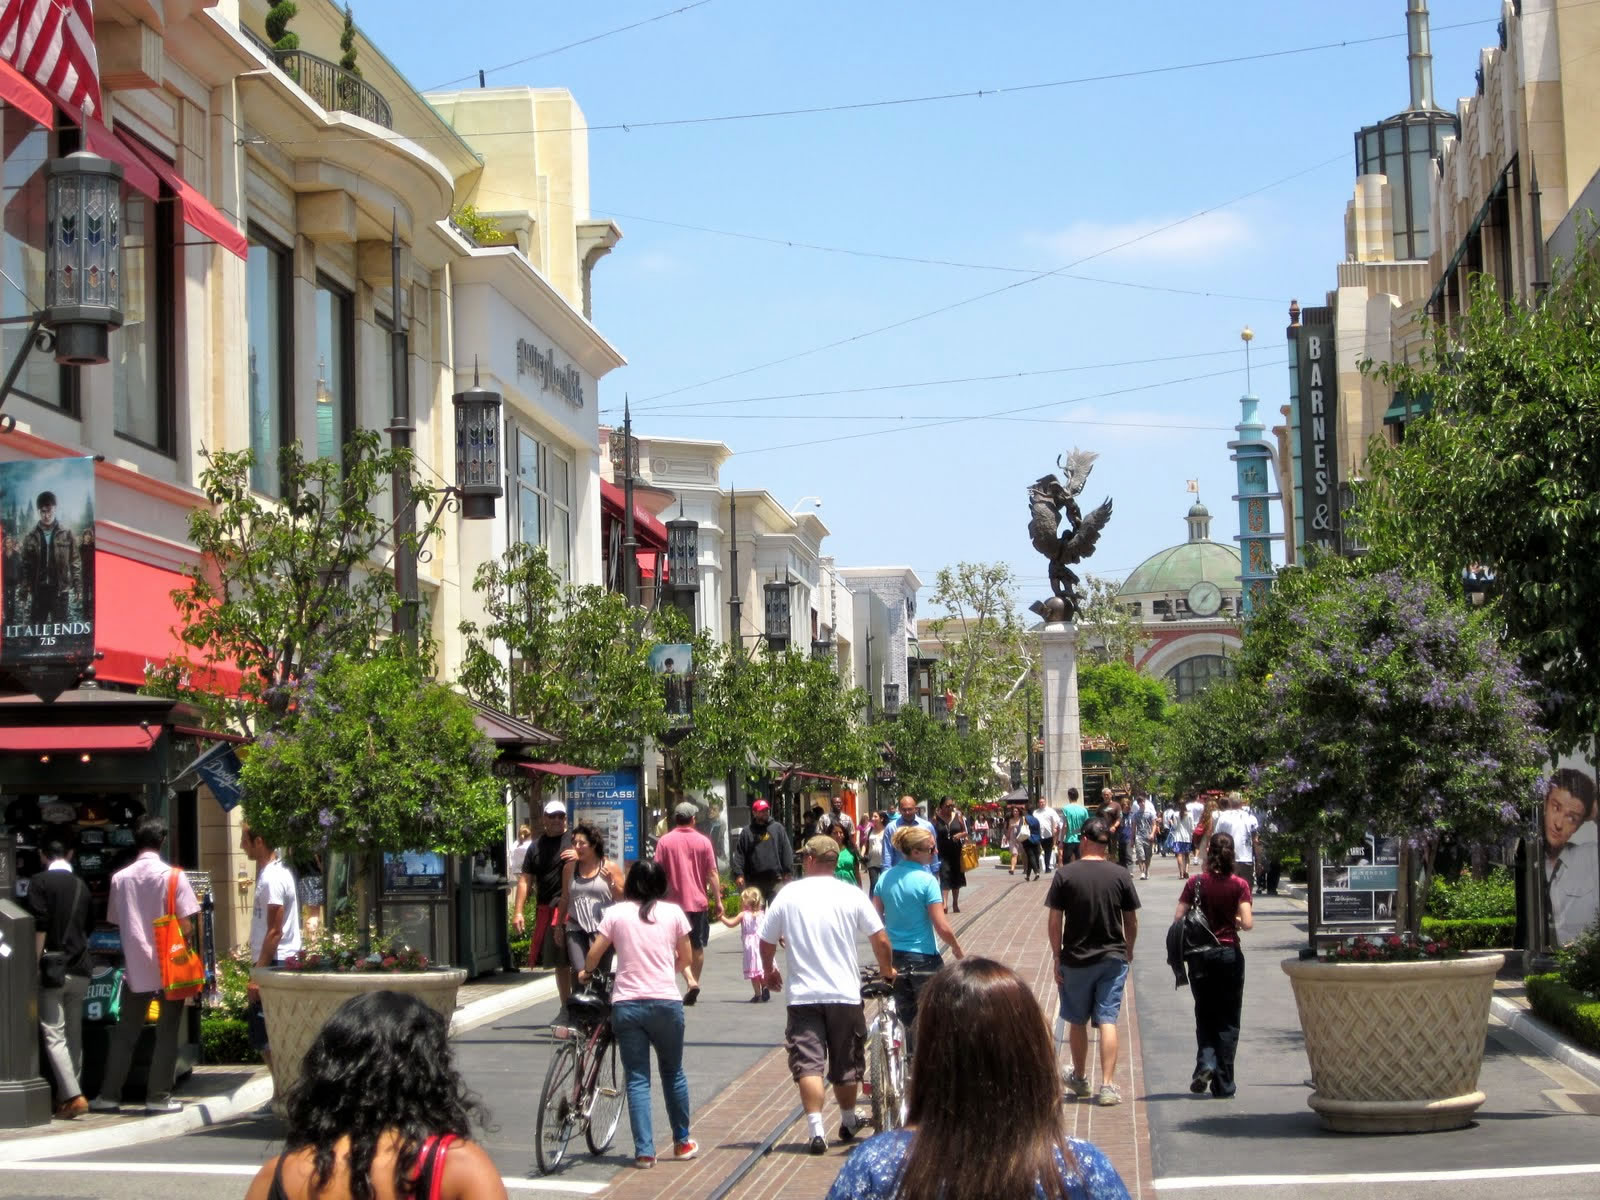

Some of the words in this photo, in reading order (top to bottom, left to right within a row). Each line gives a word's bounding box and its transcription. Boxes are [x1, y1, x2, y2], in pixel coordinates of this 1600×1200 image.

[1308, 335, 1328, 496] BARNES
[1311, 503, 1330, 531] &
[1247, 498, 1266, 611] GRO
[6, 624, 20, 638] IT
[23, 623, 51, 637] ALL
[53, 621, 92, 636] ENDS
[40, 637, 57, 646] 7.15
[597, 790, 635, 799] CLASS!
[87, 1001, 102, 1021] 9
